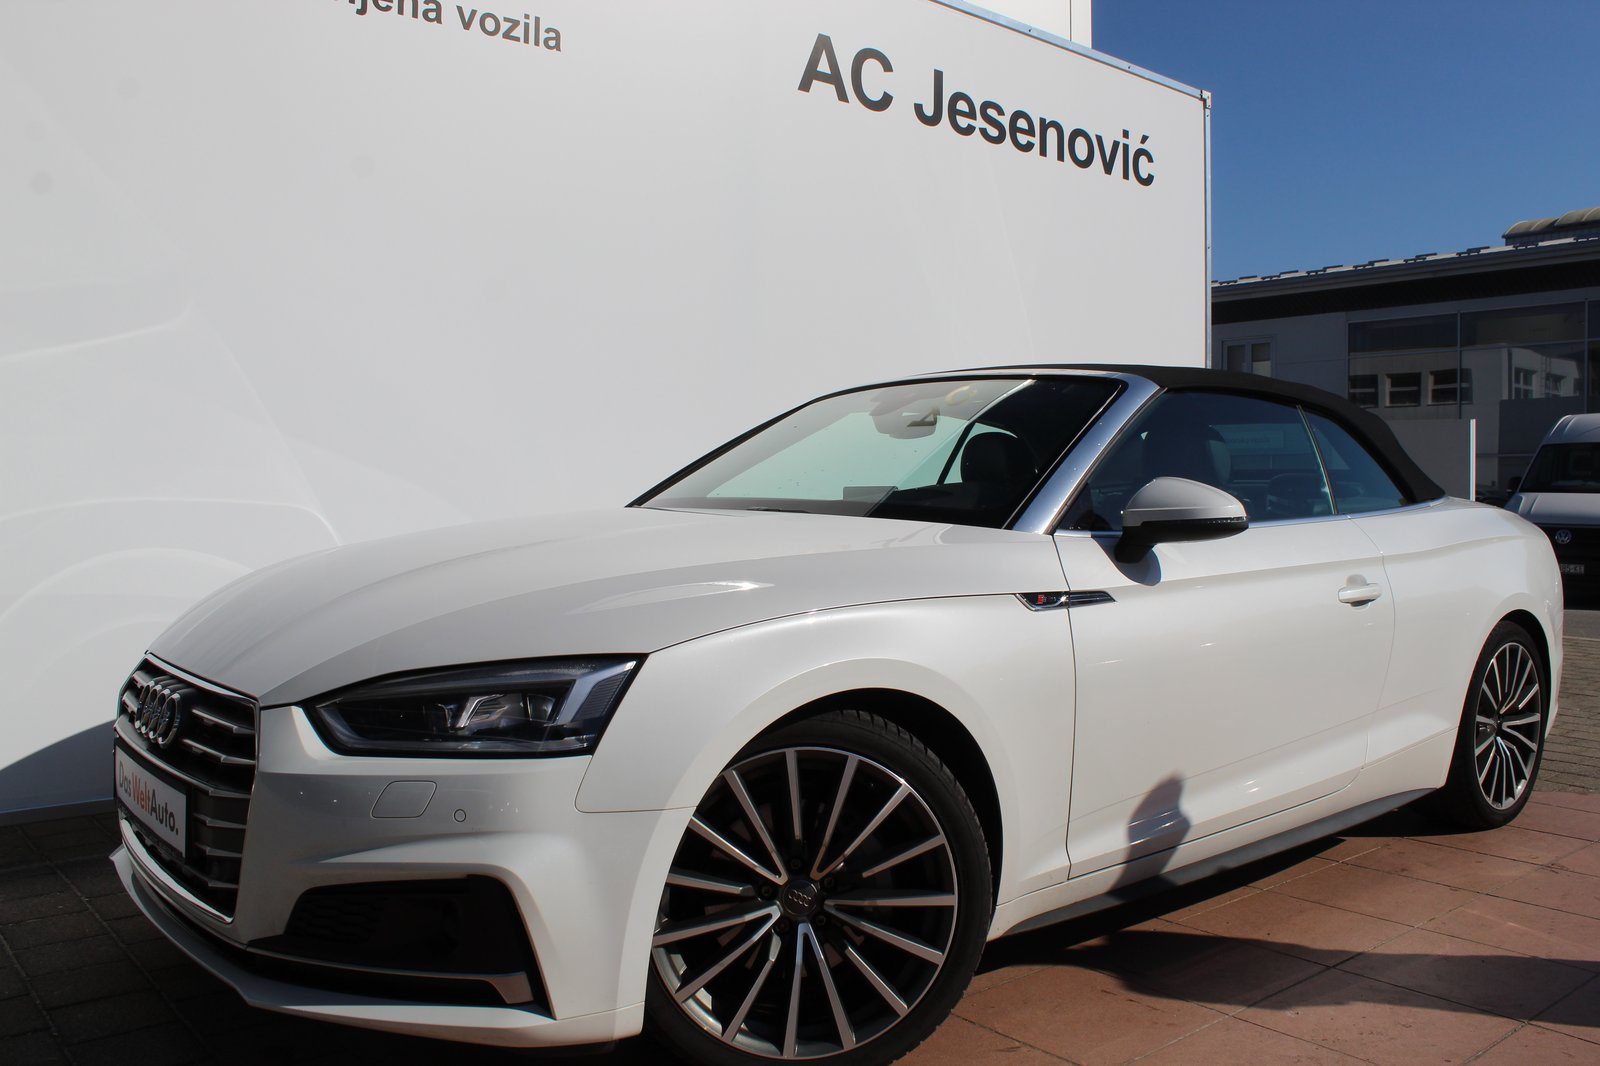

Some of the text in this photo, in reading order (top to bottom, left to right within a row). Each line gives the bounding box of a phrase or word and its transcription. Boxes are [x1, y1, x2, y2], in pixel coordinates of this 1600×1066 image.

[455, 5, 562, 53] vozila
[797, 32, 1155, 187] AC Jesenović
[119, 760, 179, 836] Das WeltAuto.
